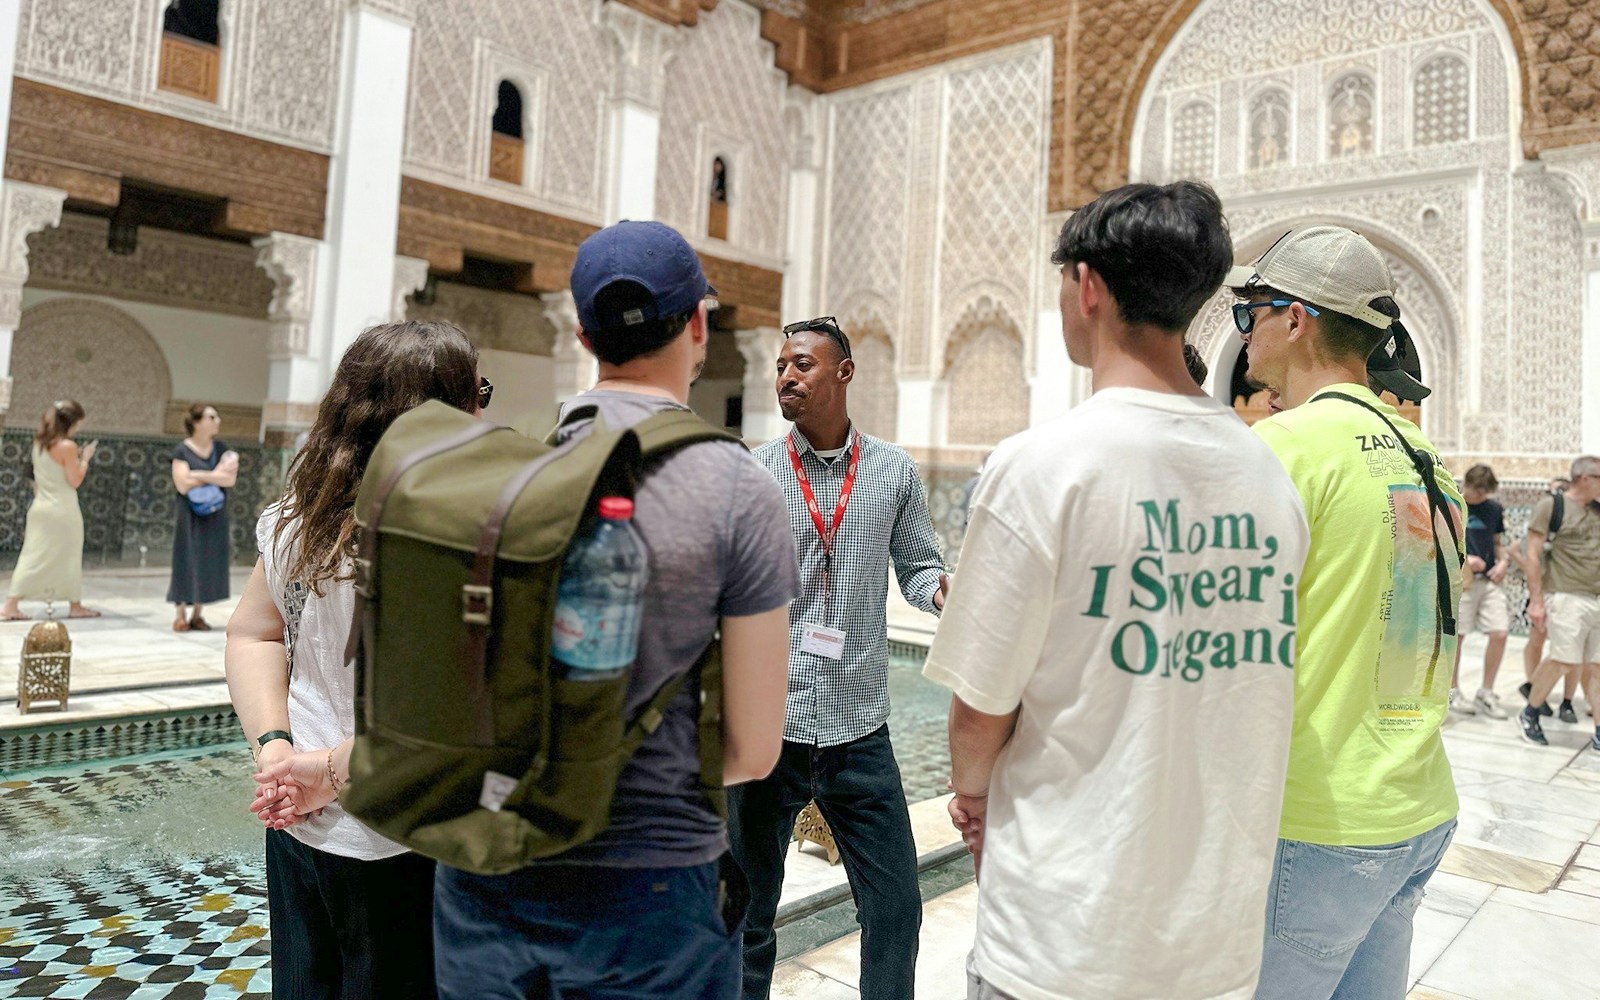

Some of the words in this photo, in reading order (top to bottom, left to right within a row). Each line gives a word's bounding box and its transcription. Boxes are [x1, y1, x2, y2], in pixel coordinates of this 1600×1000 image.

[1355, 434, 1404, 454] ZAD
[1136, 498, 1279, 560] Mom,
[1382, 510, 1389, 524] DJ
[1387, 493, 1397, 540] VOLTAIRE
[1080, 564, 1117, 619] I
[1129, 555, 1275, 617] Swear
[1277, 572, 1296, 627] i
[1383, 589, 1394, 622] TRUTH
